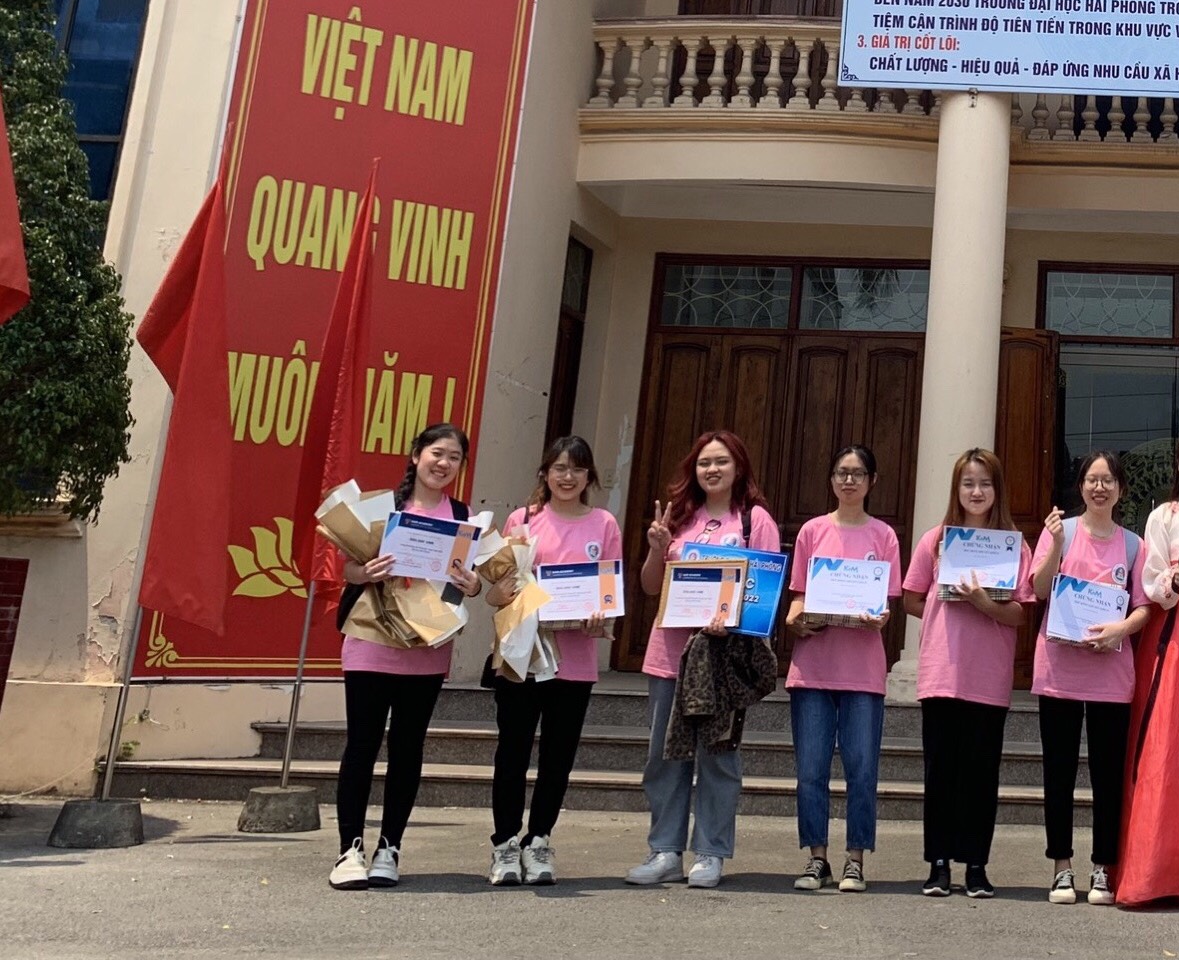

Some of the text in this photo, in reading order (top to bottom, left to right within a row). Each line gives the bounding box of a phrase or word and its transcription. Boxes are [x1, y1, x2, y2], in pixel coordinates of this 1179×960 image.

[300, 6, 474, 126] VIỆT NAM
[857, 35, 867, 48] 3.
[388, 199, 475, 290] VINH
